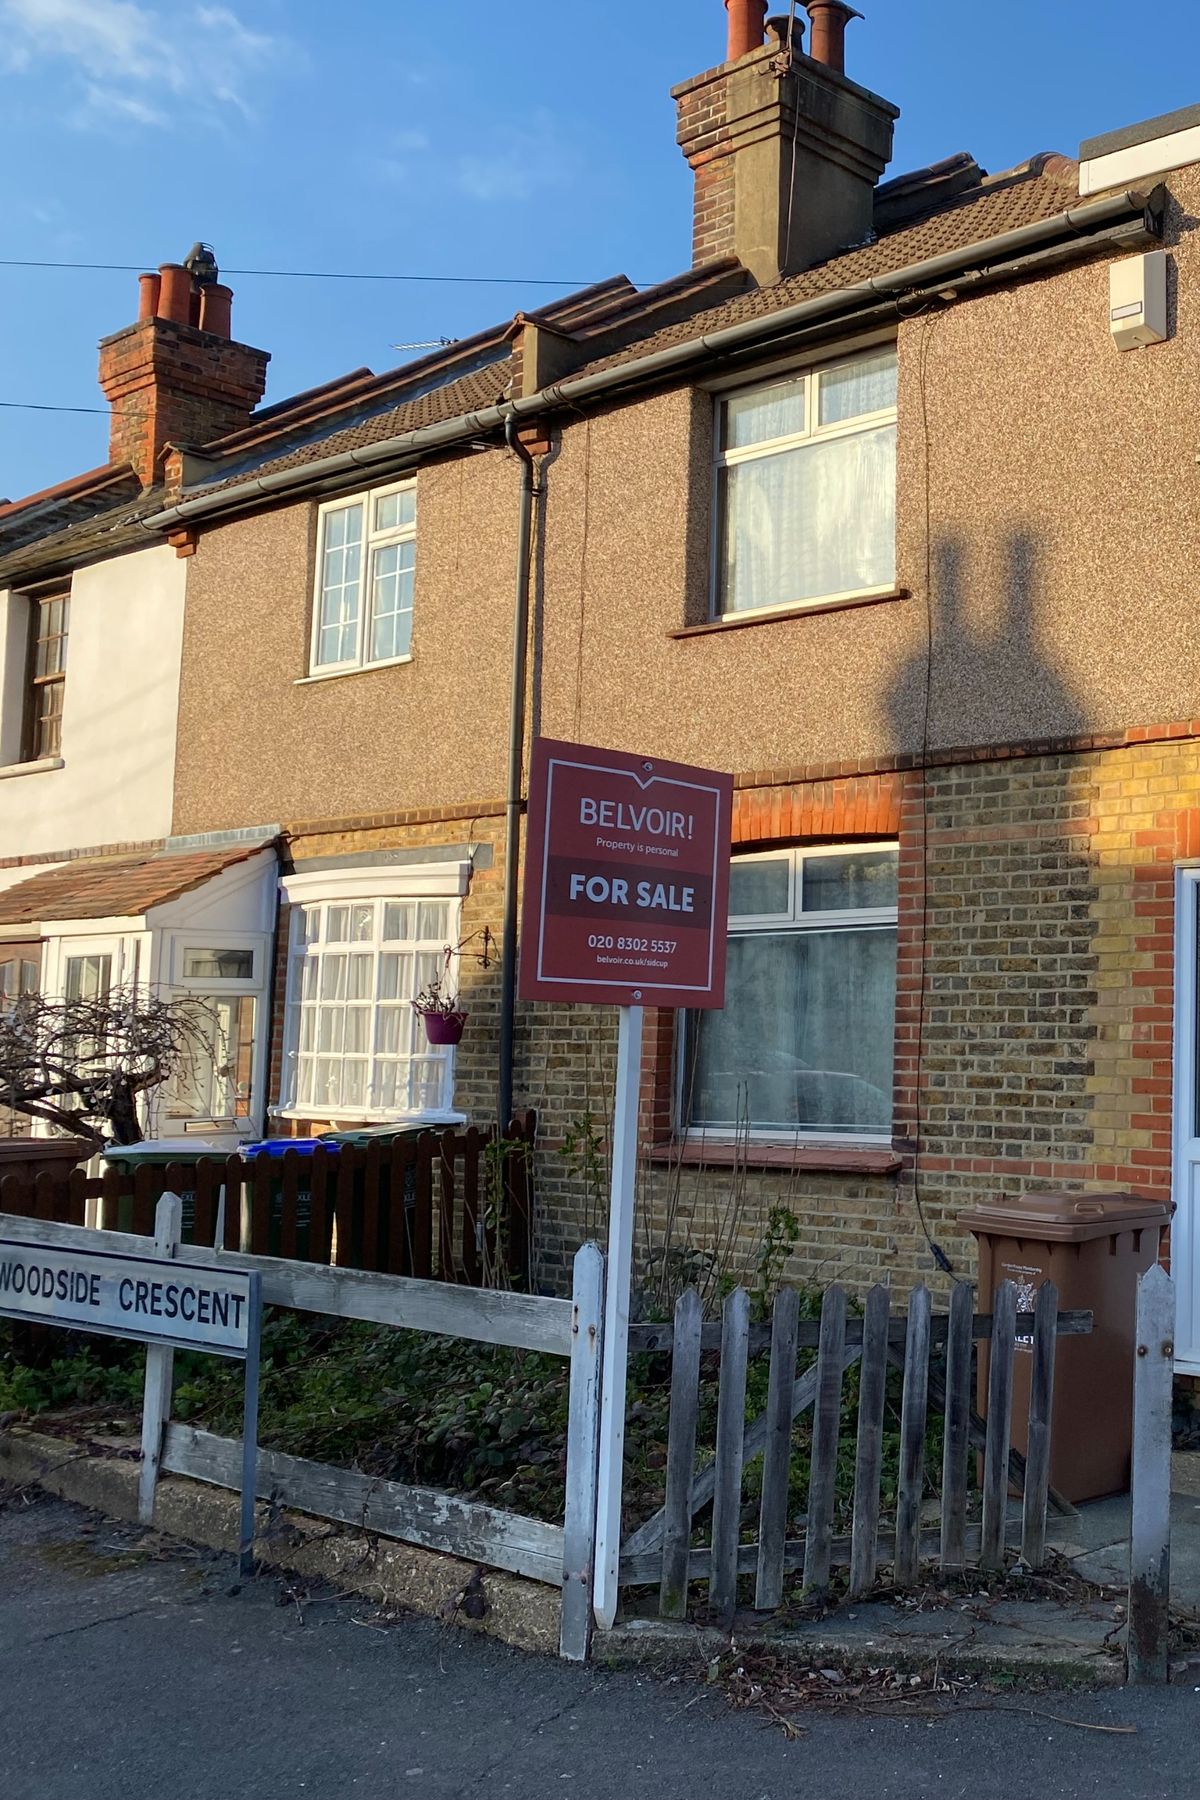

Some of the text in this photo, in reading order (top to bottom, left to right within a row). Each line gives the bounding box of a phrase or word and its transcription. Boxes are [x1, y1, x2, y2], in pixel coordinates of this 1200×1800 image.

[579, 797, 694, 840] BELVOIR!
[596, 837, 679, 857] Property is personal
[569, 873, 695, 912] FOR SALE
[588, 935, 677, 954] 020 8302 5537
[596, 955, 669, 969] belvoir.co.uk/sidcup
[0, 1261, 246, 1329] WOODSIDE CRESCENT
